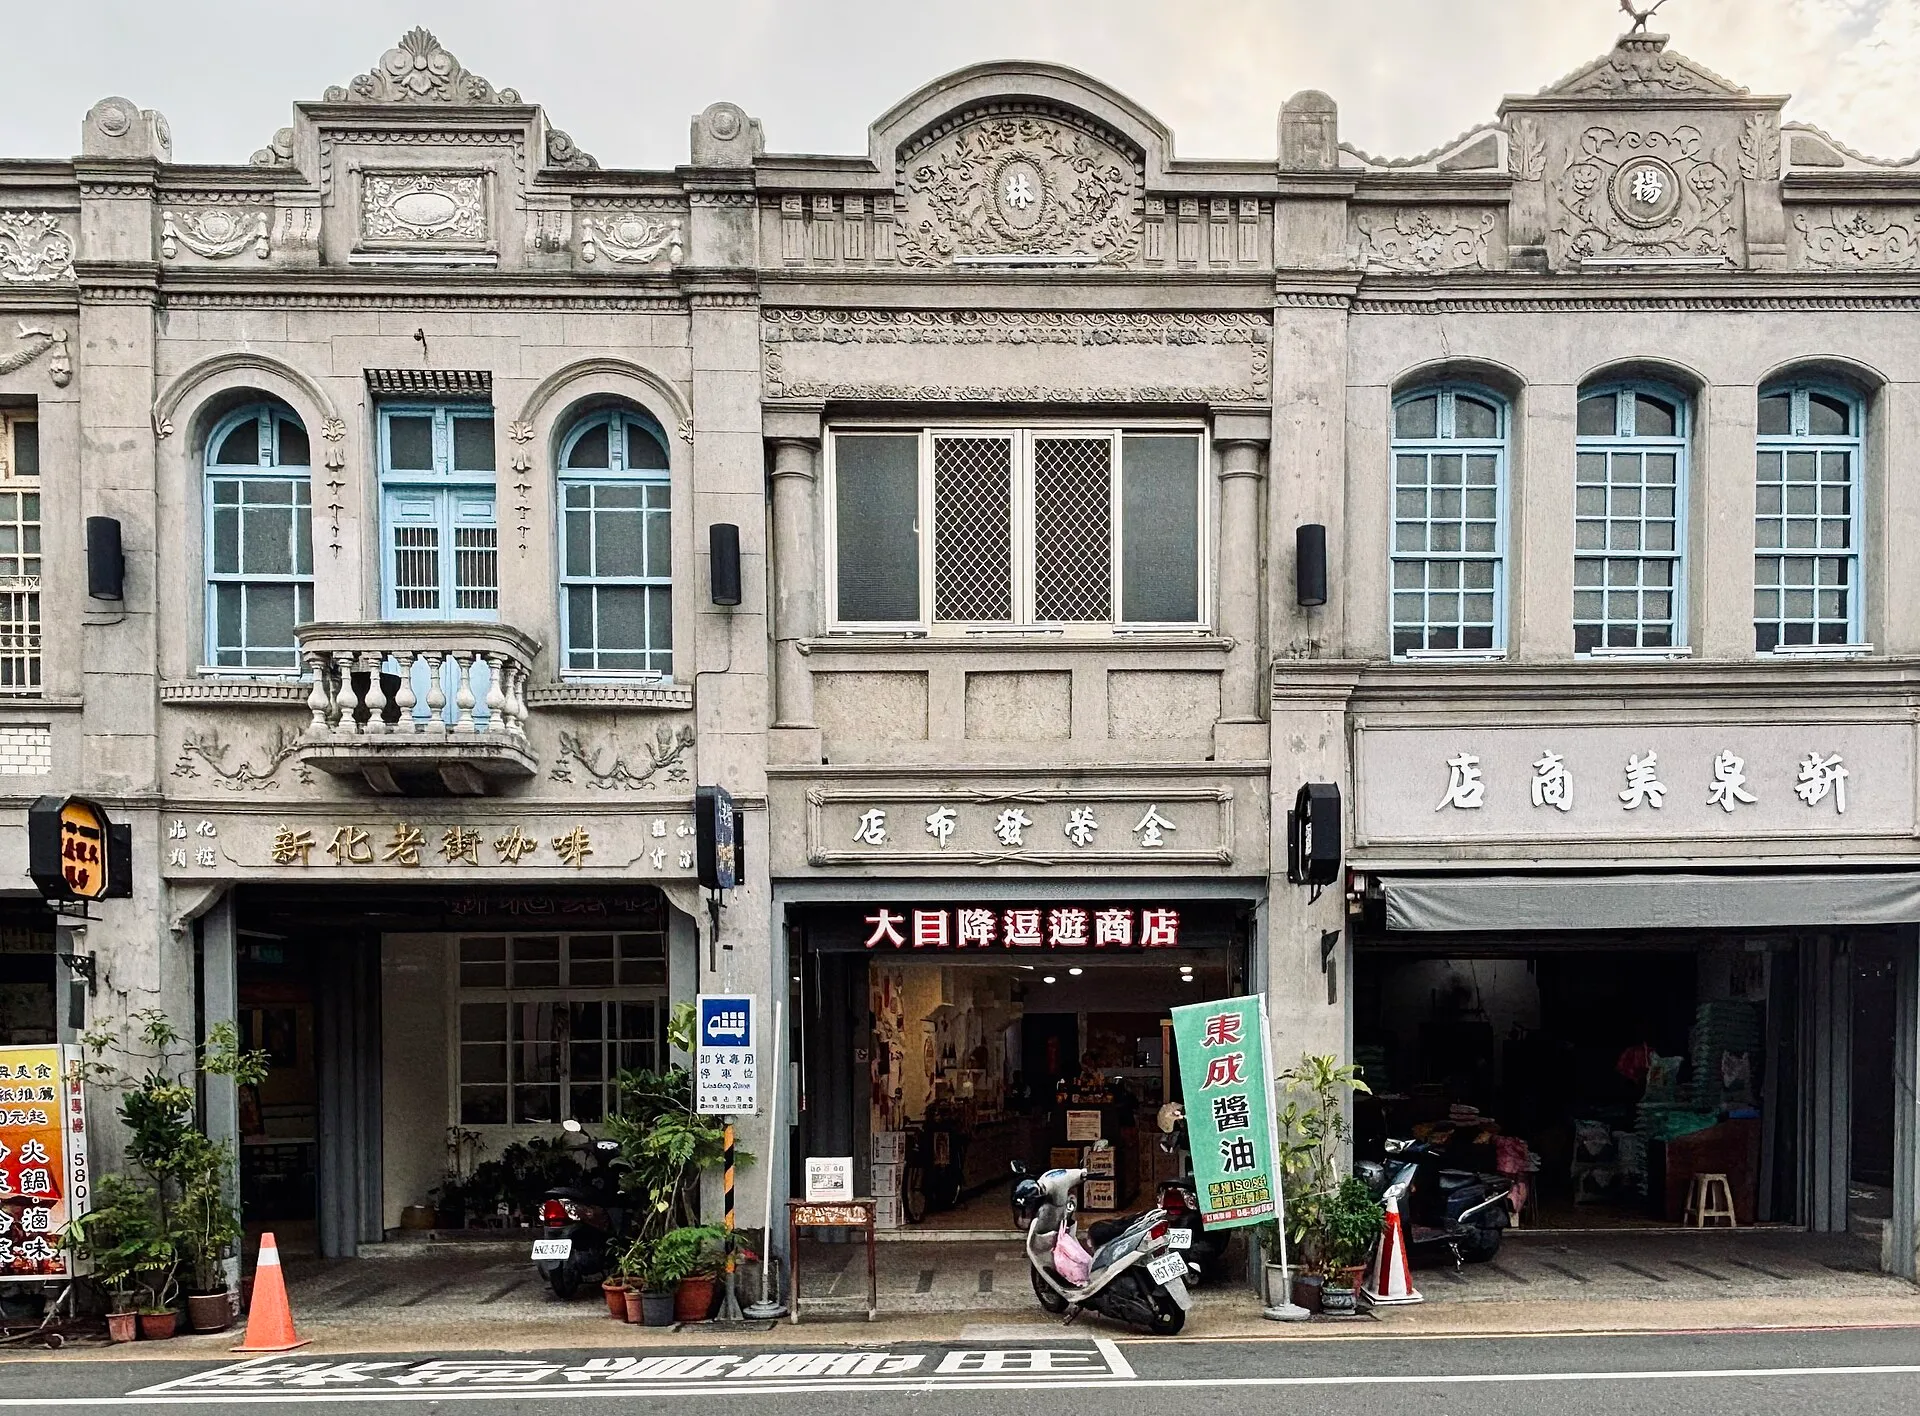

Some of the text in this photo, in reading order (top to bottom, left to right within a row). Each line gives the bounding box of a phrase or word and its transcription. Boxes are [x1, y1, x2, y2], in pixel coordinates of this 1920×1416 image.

[1006, 173, 1034, 209] 林
[1632, 171, 1662, 203] 楊
[1436, 749, 1849, 813] 新泉美商店
[270, 823, 595, 869] 新化老街咖啡
[853, 804, 1176, 848] 金榮發布店
[864, 907, 1180, 948] 大目降逗遊商店
[1200, 1011, 1258, 1175] 東成醬油
